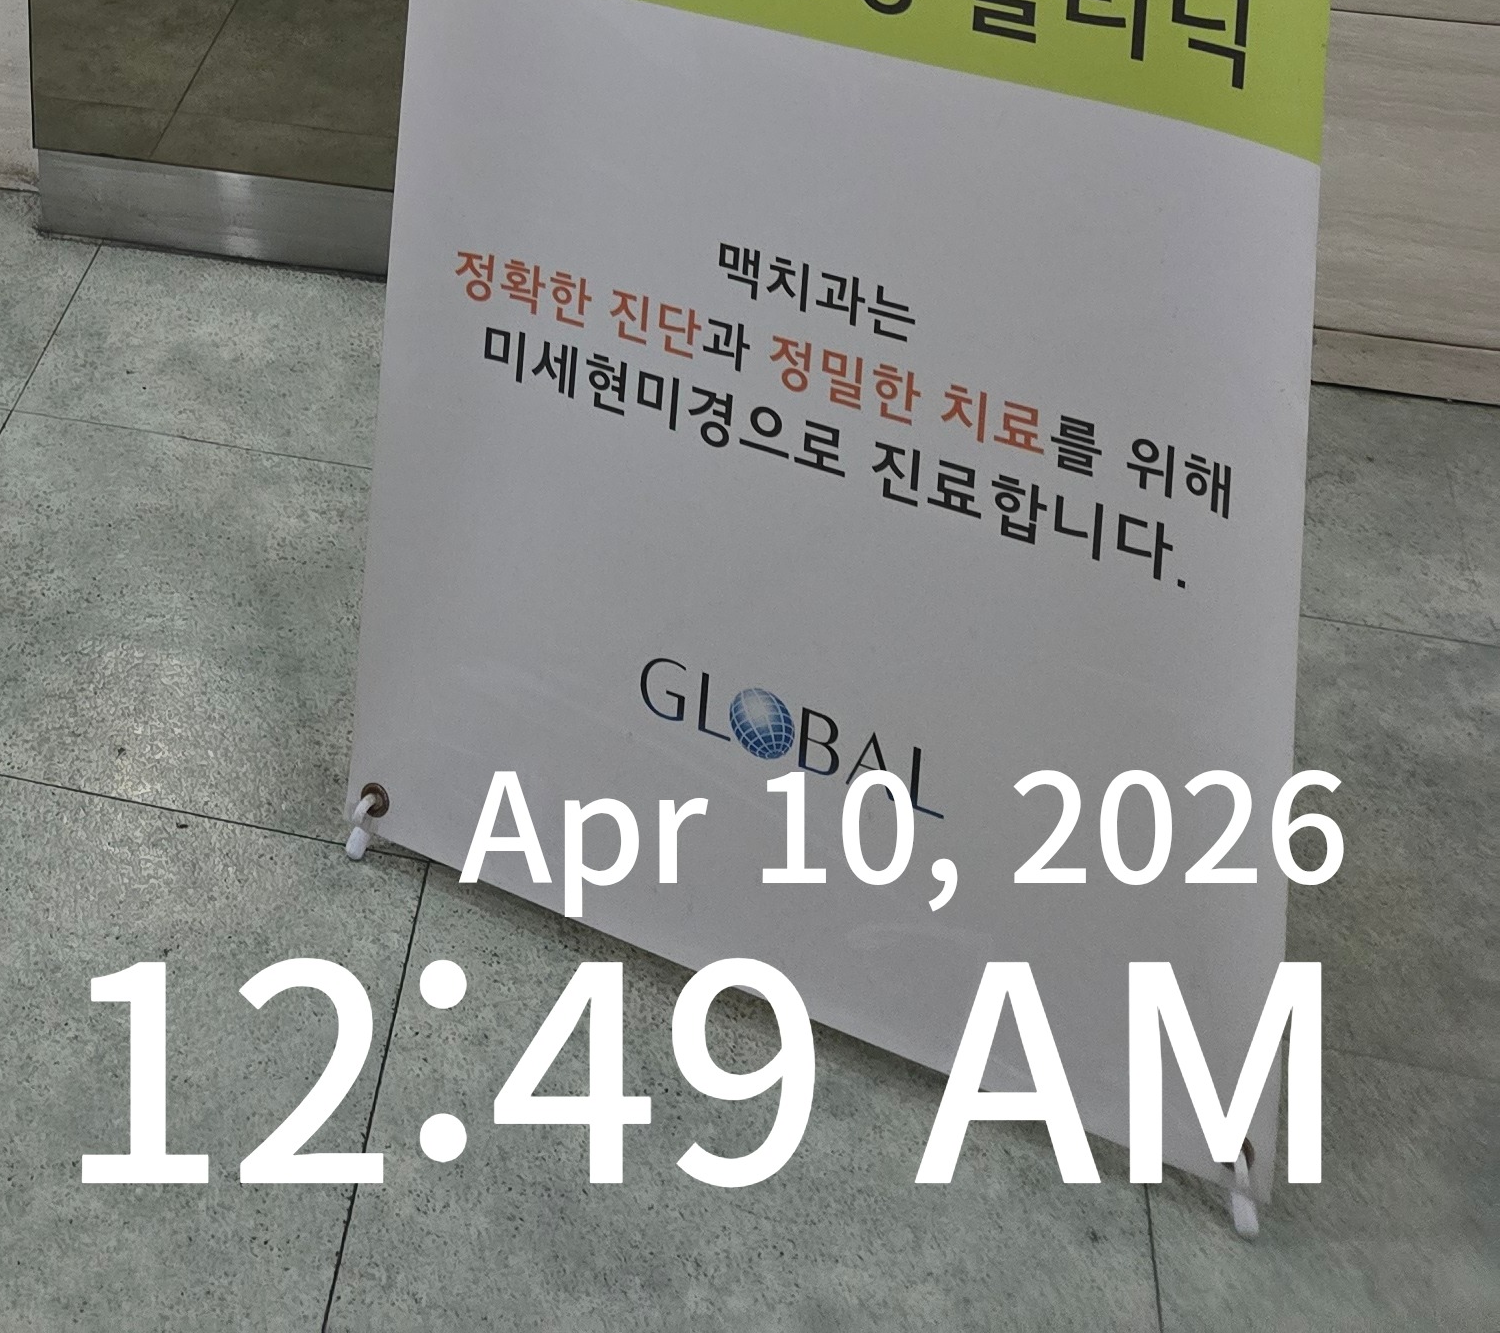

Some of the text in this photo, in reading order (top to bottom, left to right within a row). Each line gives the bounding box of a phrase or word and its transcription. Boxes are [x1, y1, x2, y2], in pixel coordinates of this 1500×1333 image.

[454, 248, 1233, 521] 정확한 진단과 정밀한 치료를 위해
[717, 241, 916, 342] 맥치과는
[483, 325, 1187, 590] 미세현미경으로 진료합니다.
[639, 656, 945, 820] GLOBAL
